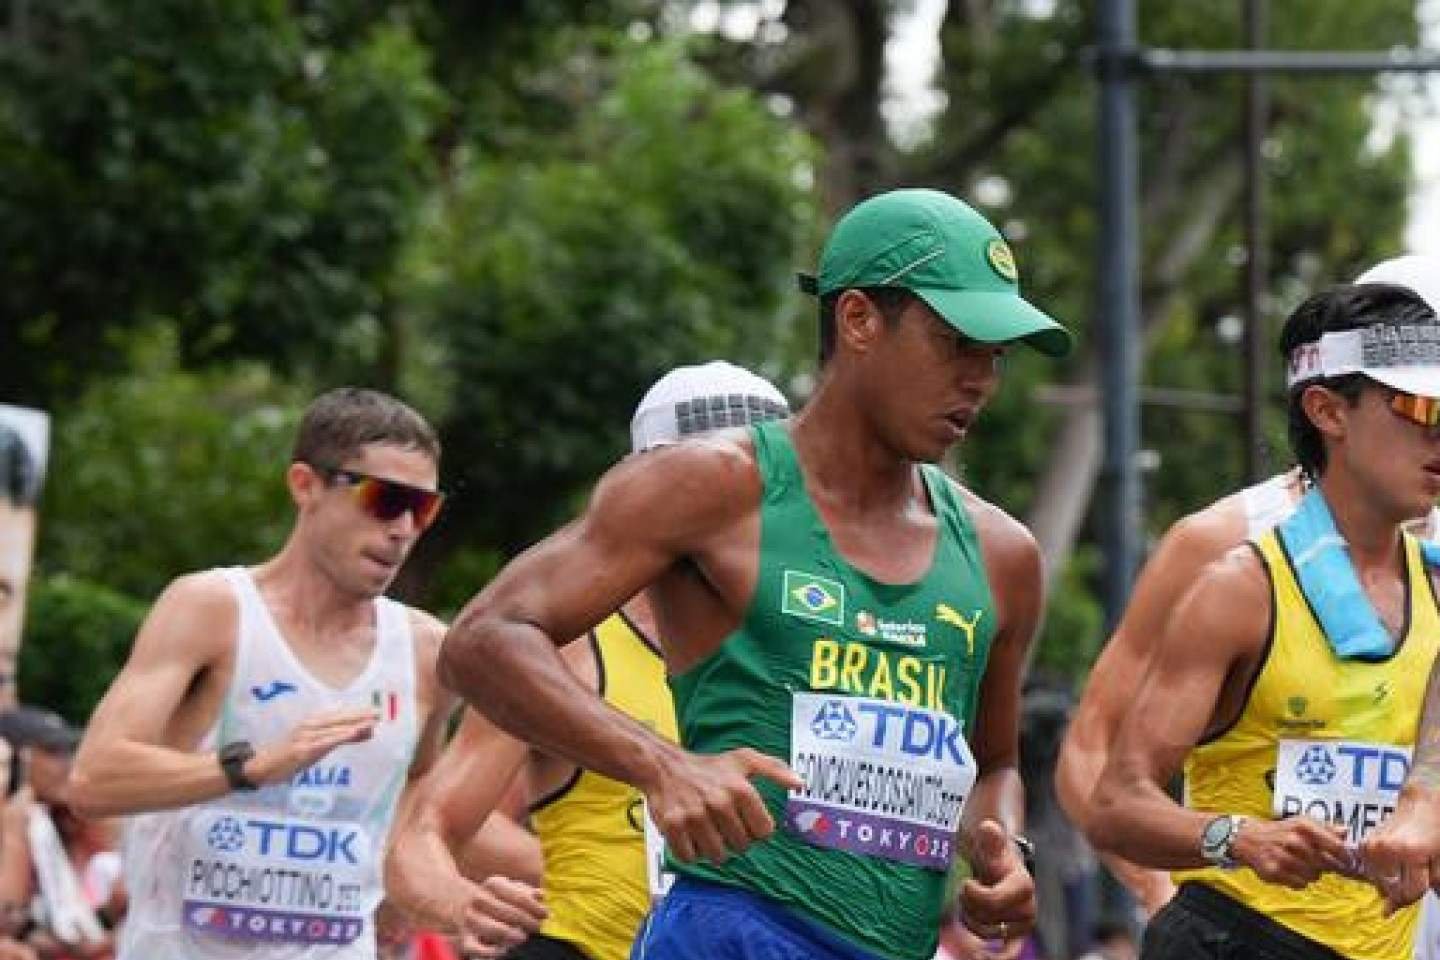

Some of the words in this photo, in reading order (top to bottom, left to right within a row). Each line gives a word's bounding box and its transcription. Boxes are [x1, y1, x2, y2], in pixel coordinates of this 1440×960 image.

[857, 703, 965, 766] TDK
[1337, 747, 1410, 791] TD
[247, 820, 358, 864] TDK
[835, 819, 949, 858] TOKYO25
